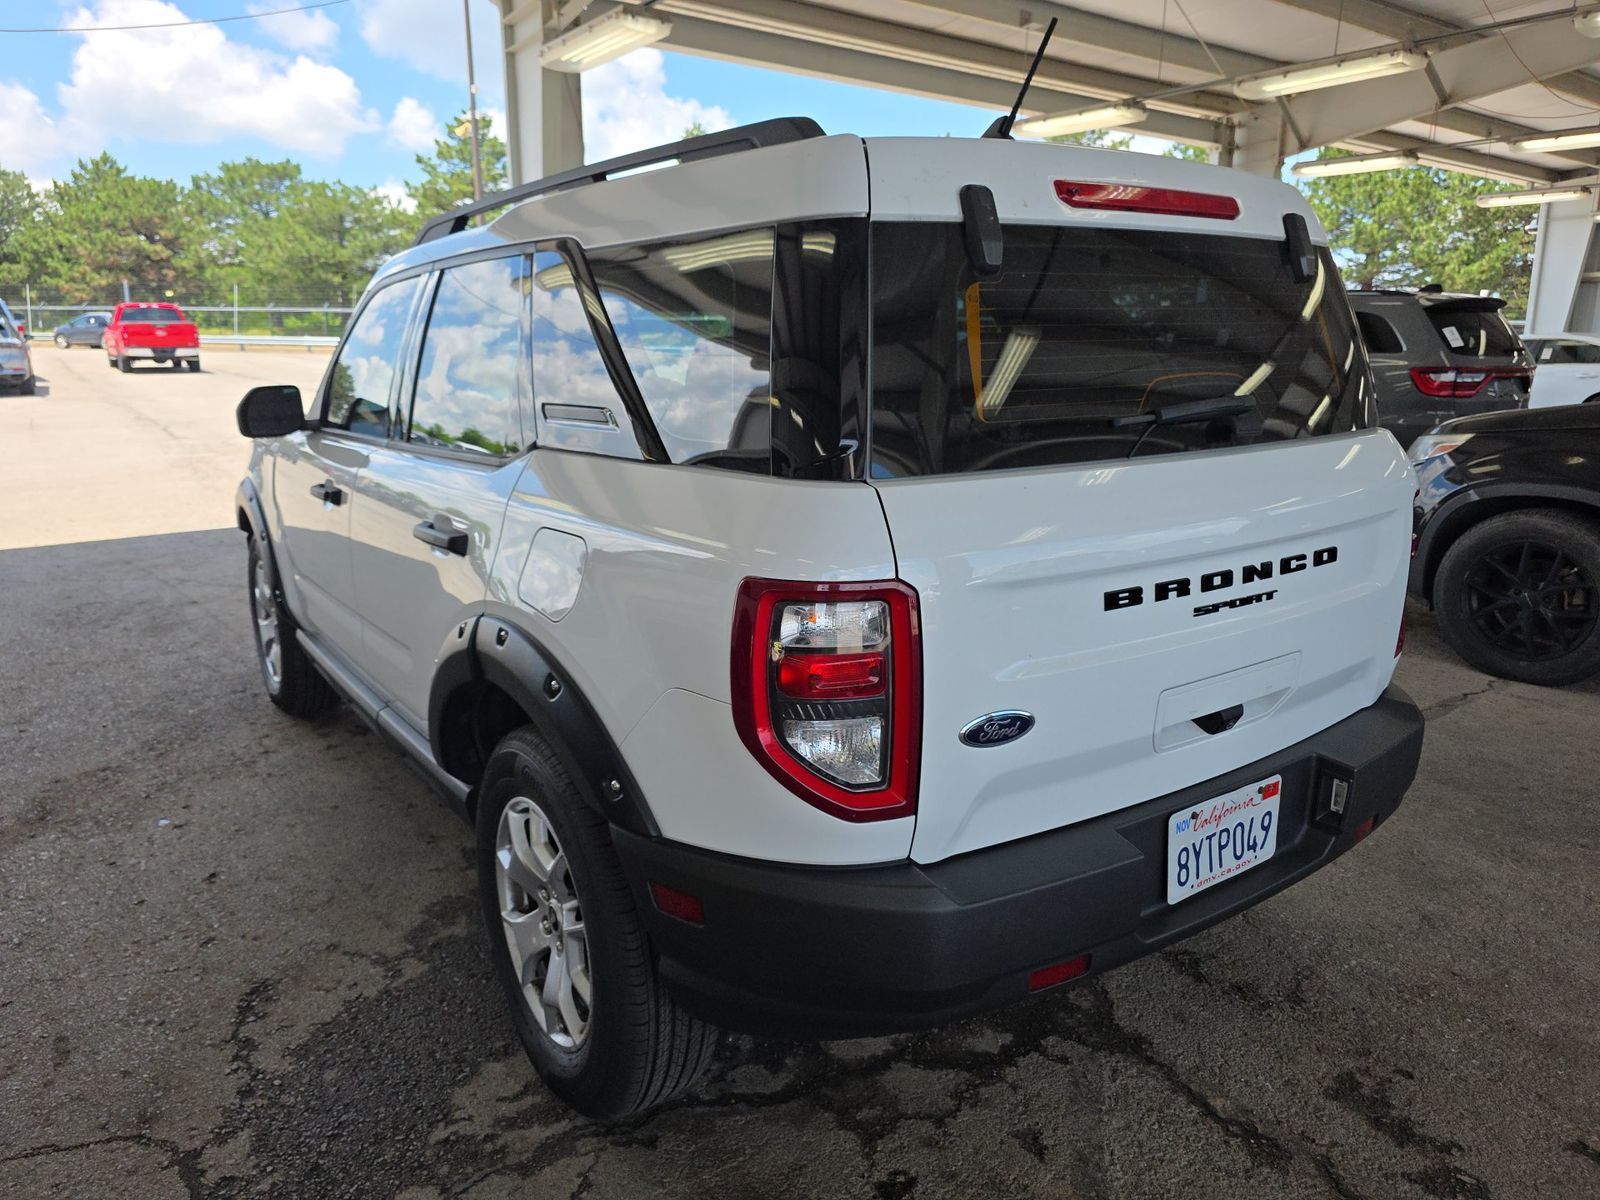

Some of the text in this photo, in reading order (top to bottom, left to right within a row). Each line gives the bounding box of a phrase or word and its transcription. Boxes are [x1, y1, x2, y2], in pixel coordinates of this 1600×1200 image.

[1103, 546, 1338, 612] BRONCO
[1193, 589, 1279, 617] SPORT
[979, 718, 1021, 742] Ford
[1175, 818, 1192, 835] NOV
[1193, 794, 1261, 832] California
[1177, 810, 1273, 887] 8YTP049
[1196, 858, 1252, 888] dmv.ca.gov
